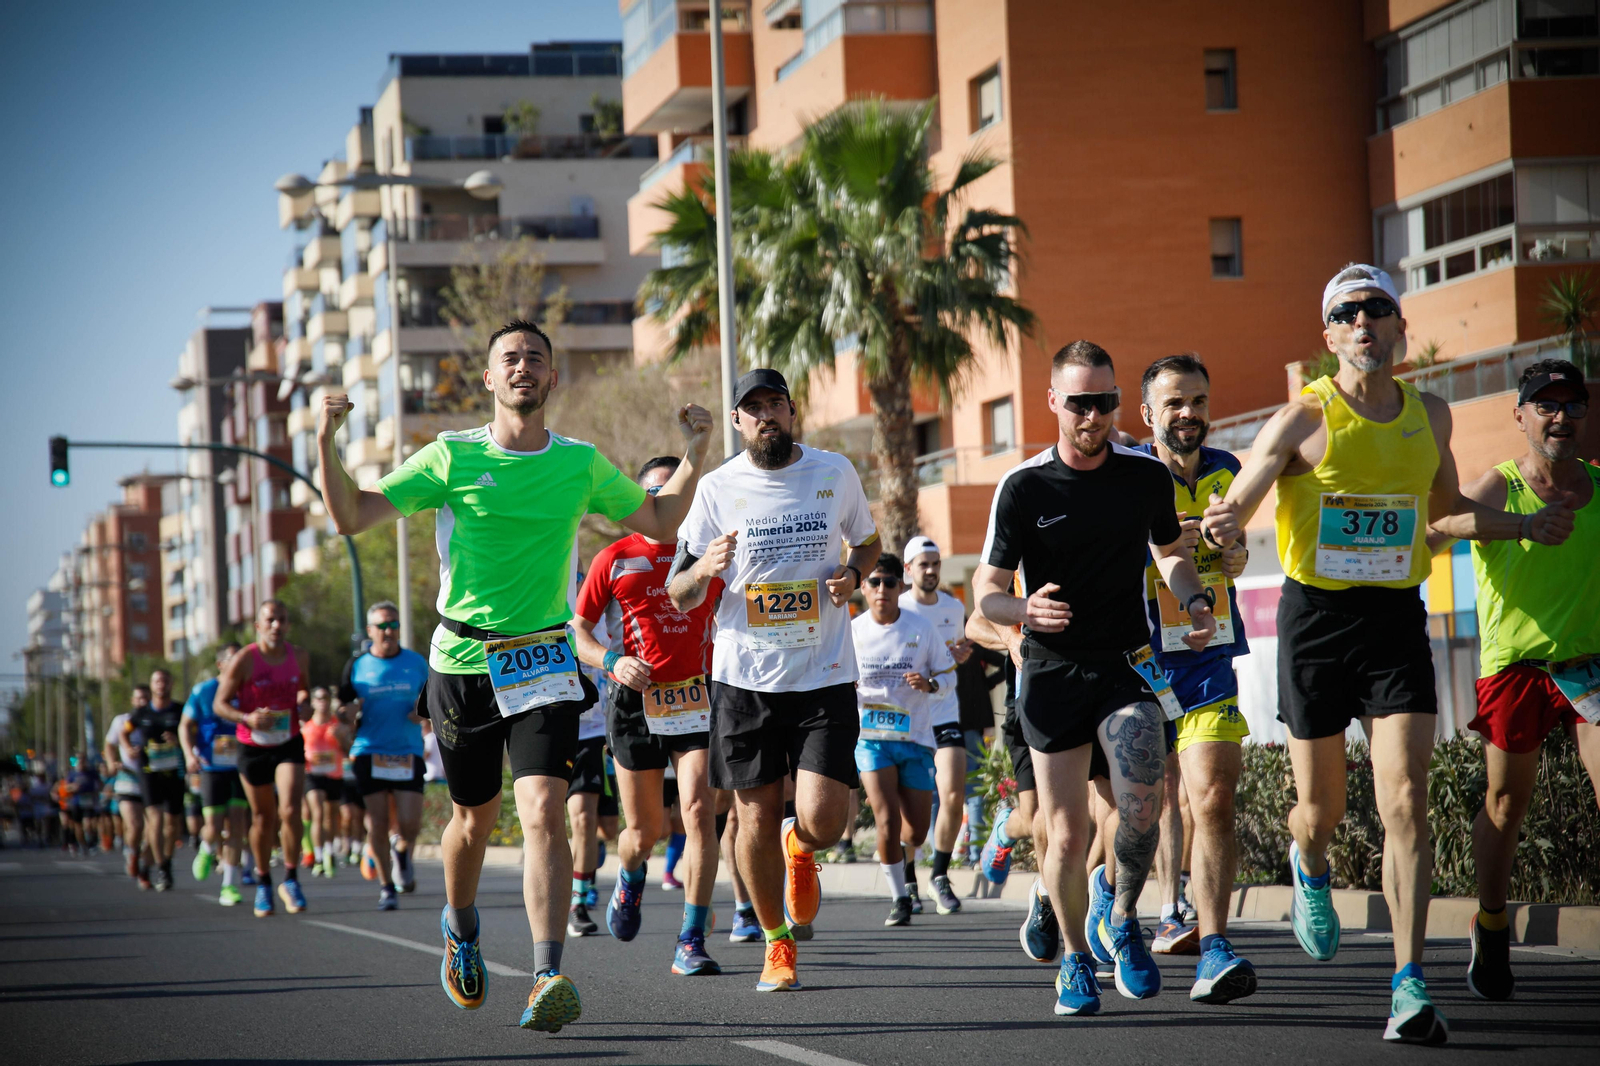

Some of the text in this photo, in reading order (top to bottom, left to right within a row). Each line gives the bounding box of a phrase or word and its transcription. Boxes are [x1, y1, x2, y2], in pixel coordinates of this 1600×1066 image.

[745, 511, 827, 526] Medio Maratón
[1341, 510, 1399, 535] 378
[747, 520, 828, 538] Almería 2024
[747, 534, 829, 548] RAMÓN RUIZ ANDÚJAR
[1352, 536, 1386, 544] JUANJO
[753, 591, 812, 614] 1229
[496, 644, 567, 676] 2093
[891, 662, 913, 670] 2024
[522, 665, 550, 678] ALVARO
[1141, 660, 1163, 681] 2
[651, 685, 701, 706] 1810
[868, 710, 907, 726] 1687
